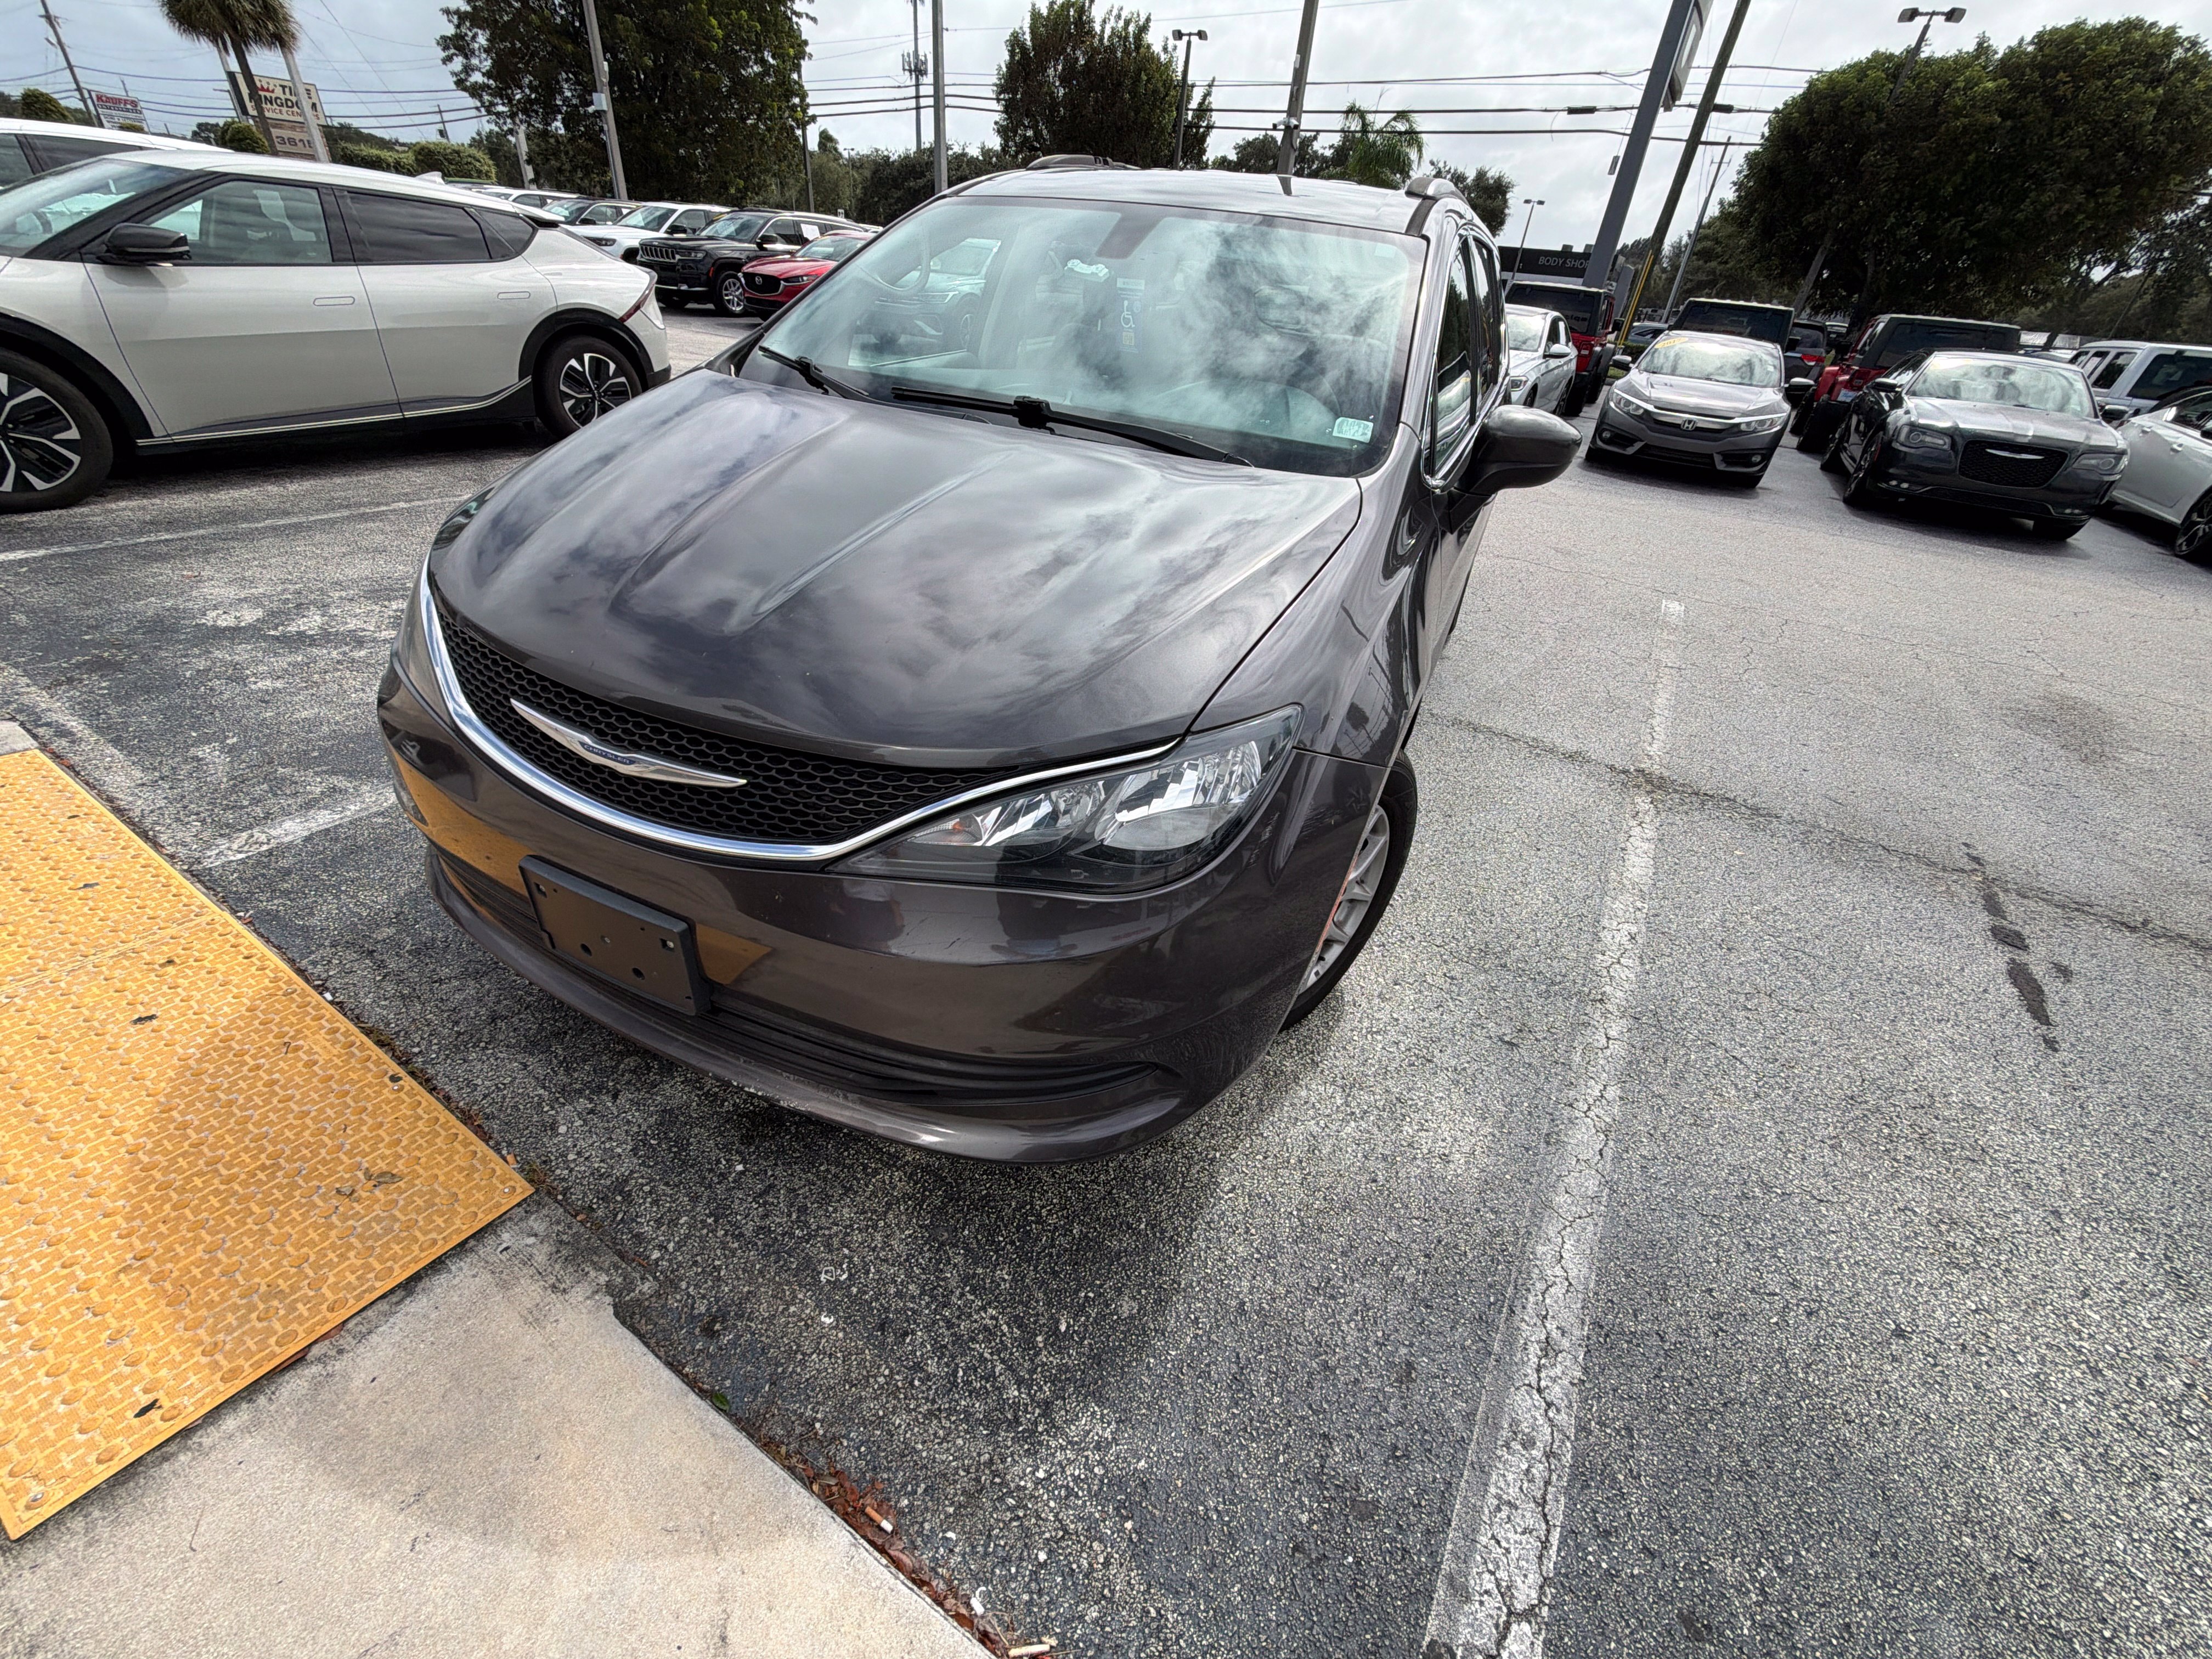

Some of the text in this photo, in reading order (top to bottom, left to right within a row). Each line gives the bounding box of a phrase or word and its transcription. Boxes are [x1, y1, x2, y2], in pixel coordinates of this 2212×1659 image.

[279, 84, 312, 100] TIE
[1538, 256, 1565, 267] BODY
[584, 744, 630, 764] CHRYSLER
